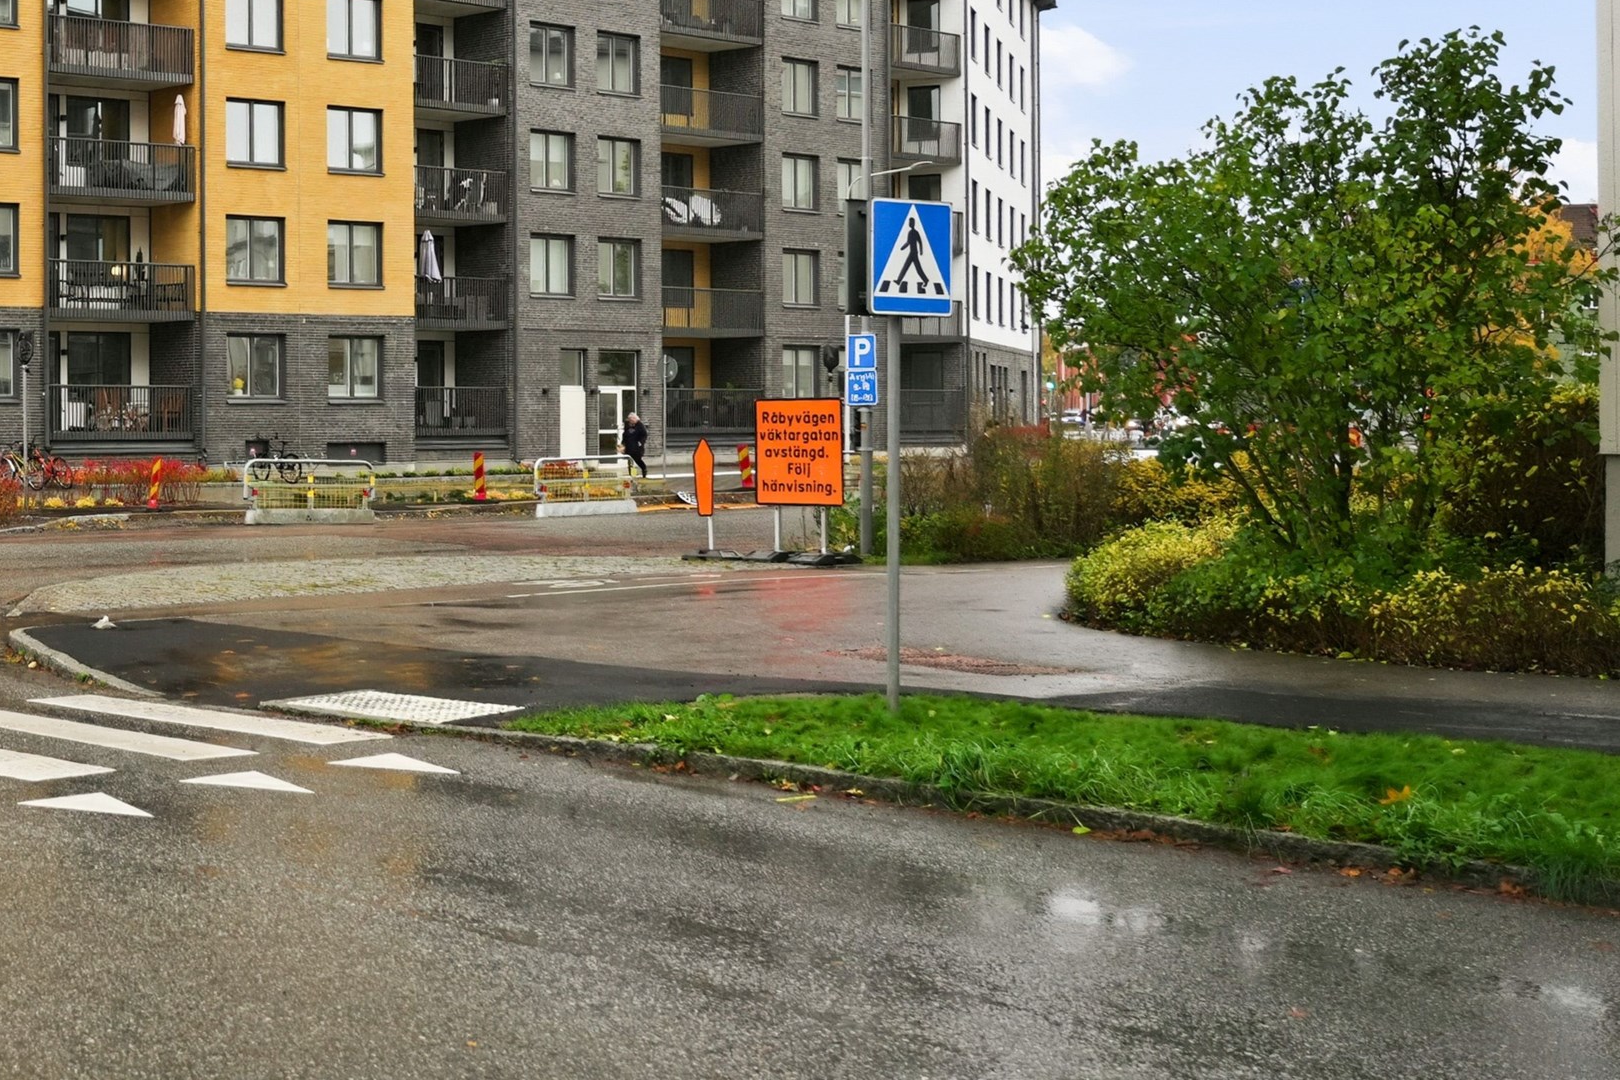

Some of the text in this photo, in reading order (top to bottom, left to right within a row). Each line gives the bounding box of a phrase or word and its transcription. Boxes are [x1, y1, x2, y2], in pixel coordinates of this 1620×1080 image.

[854, 337, 871, 366] P
[762, 411, 835, 426] Råbyvägen
[760, 428, 839, 444] väktargatan
[765, 446, 829, 461] avstängd.
[787, 462, 810, 478] Följ
[762, 480, 837, 496] hänvisning.
